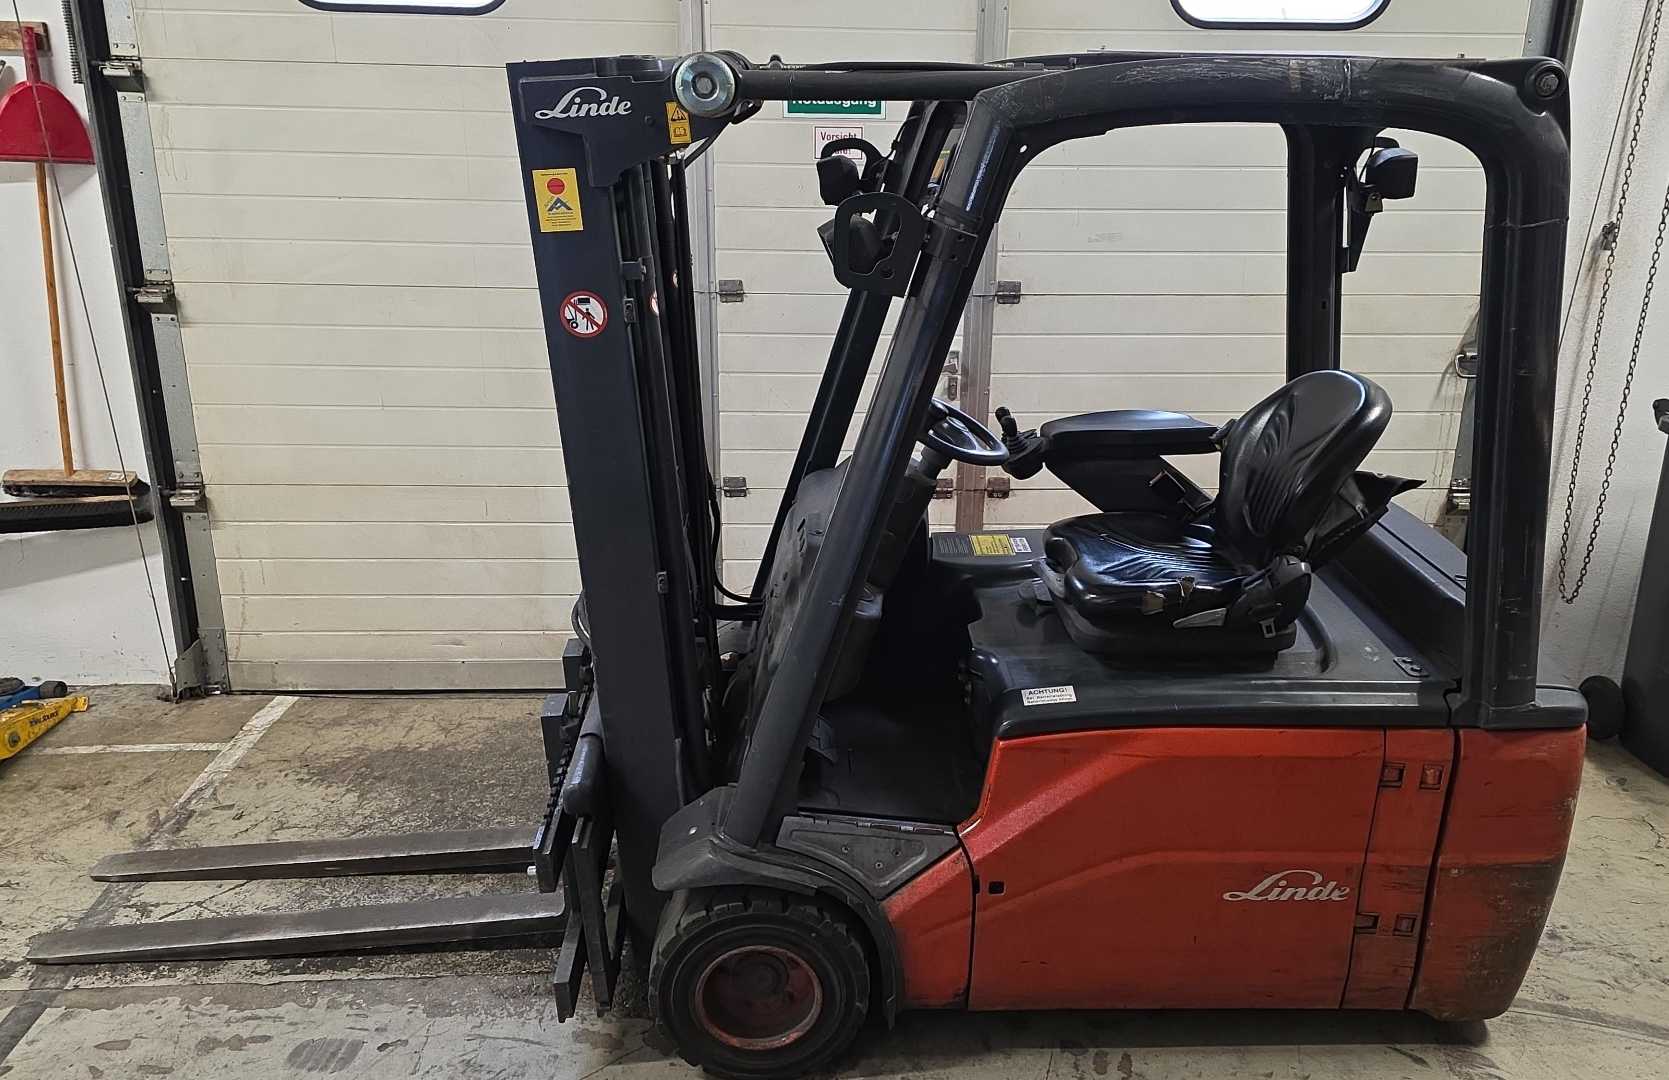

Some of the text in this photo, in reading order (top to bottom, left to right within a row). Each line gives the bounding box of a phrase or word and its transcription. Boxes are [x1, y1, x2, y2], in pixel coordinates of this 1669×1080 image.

[535, 86, 632, 119] Linde
[1028, 687, 1068, 695] ACHTUNG!
[1222, 869, 1350, 901] Linde
